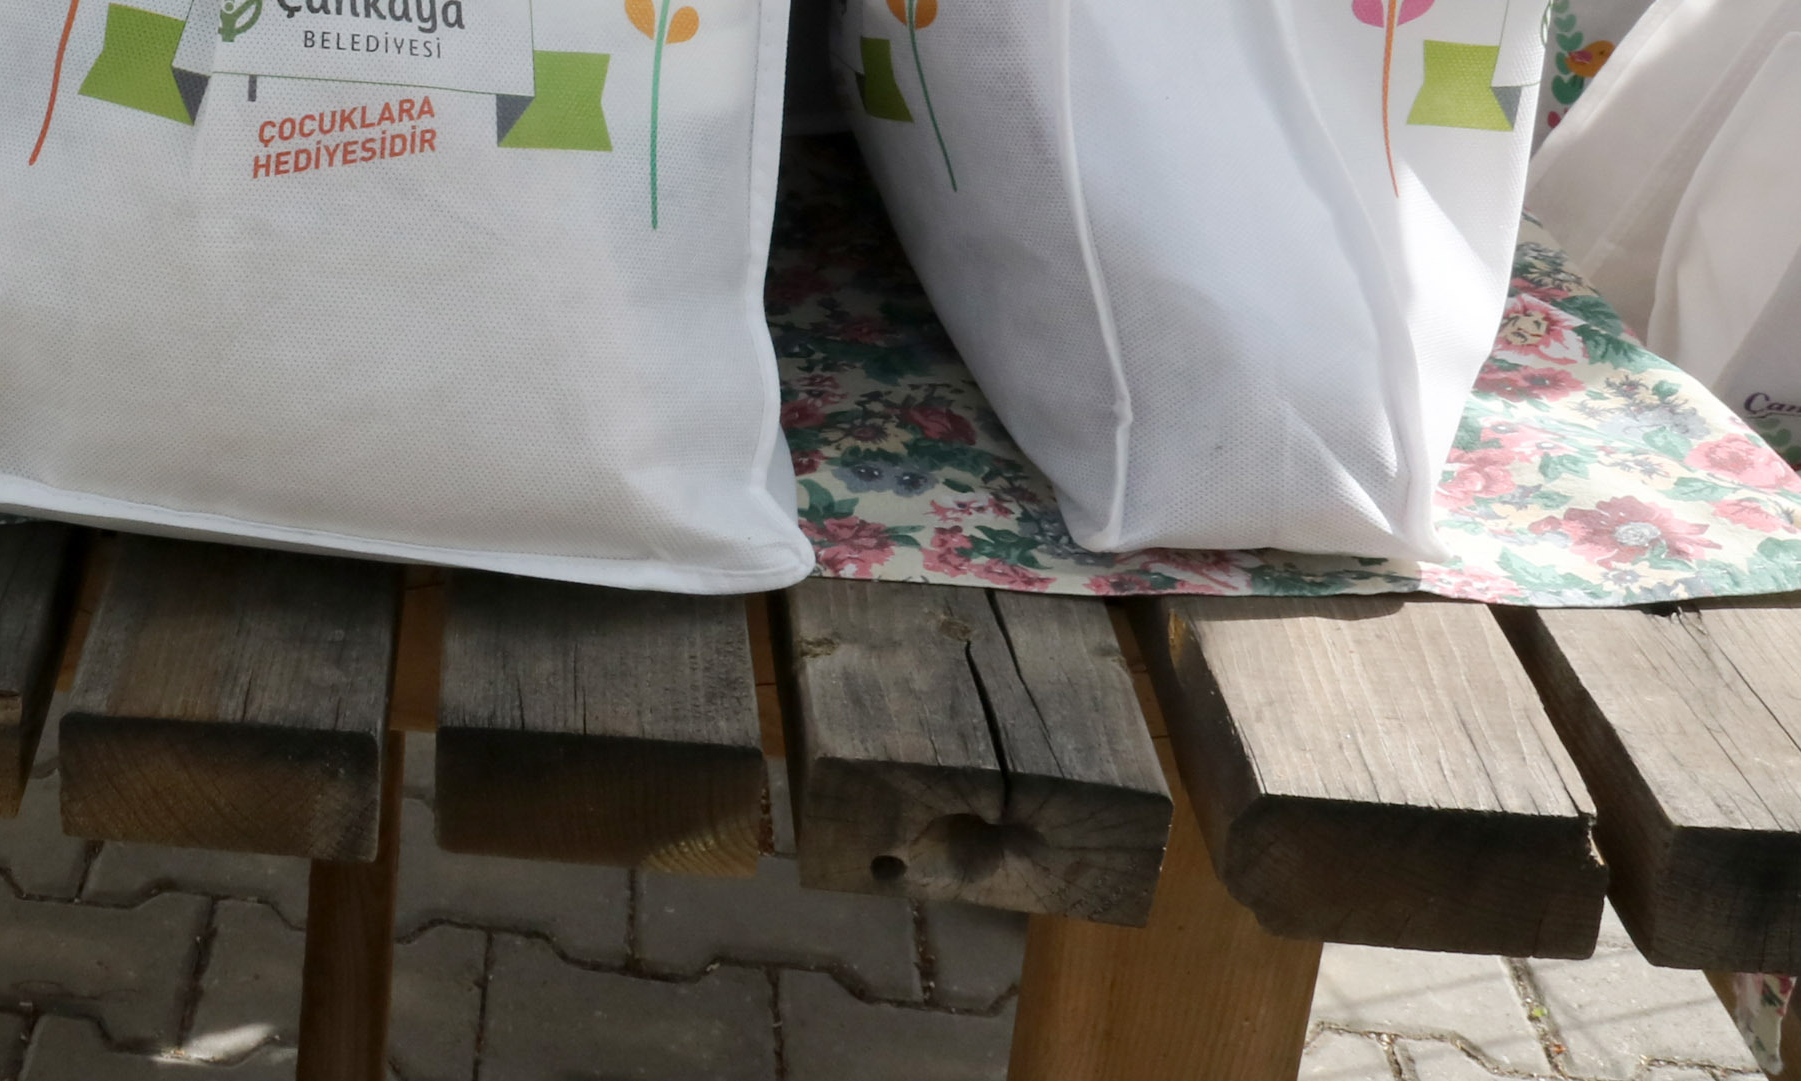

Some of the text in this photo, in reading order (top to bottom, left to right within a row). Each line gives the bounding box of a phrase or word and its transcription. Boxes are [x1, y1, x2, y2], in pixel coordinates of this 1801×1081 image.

[303, 30, 442, 59] BELEDİYESİ
[258, 95, 436, 148] ÇOCUKLARA
[252, 124, 437, 179] HEDİYESİDİR
